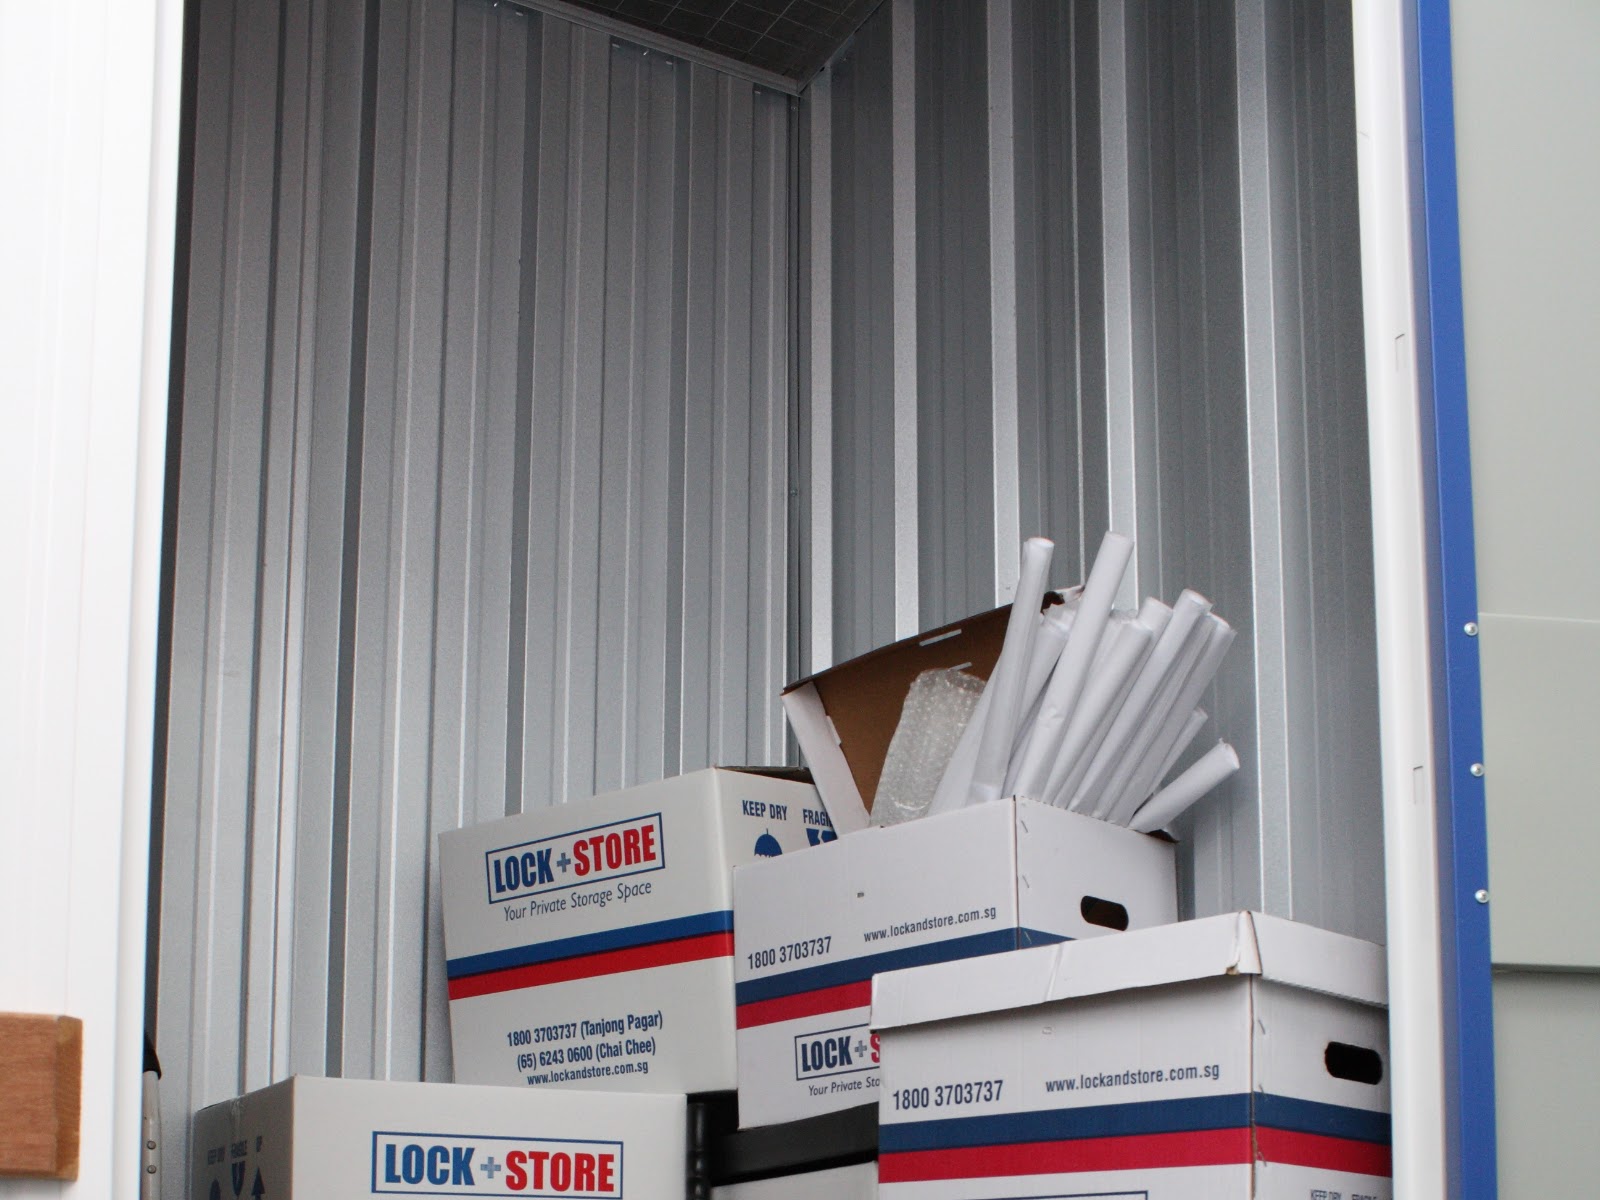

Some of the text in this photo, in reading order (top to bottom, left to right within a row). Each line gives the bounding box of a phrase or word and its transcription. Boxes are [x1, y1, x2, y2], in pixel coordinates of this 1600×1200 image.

[742, 799, 788, 821] KEEP DRY
[504, 882, 652, 921] Your Private Storage Space
[863, 906, 997, 943] www.lockandstore.com.sg
[747, 936, 832, 970] 1800 3703737
[507, 1010, 663, 1047] 1800 3703737 (Tanjong Pagar)
[517, 1036, 656, 1072] (65) 6243 0600 (Chai Chee)
[527, 1061, 649, 1085] www.lockandstore.com.sg
[808, 1085, 828, 1096] Your
[831, 1079, 863, 1093] Private
[1045, 1062, 1220, 1093] www.lockandstore.com.sg
[893, 1079, 1004, 1110] 1800 3703737
